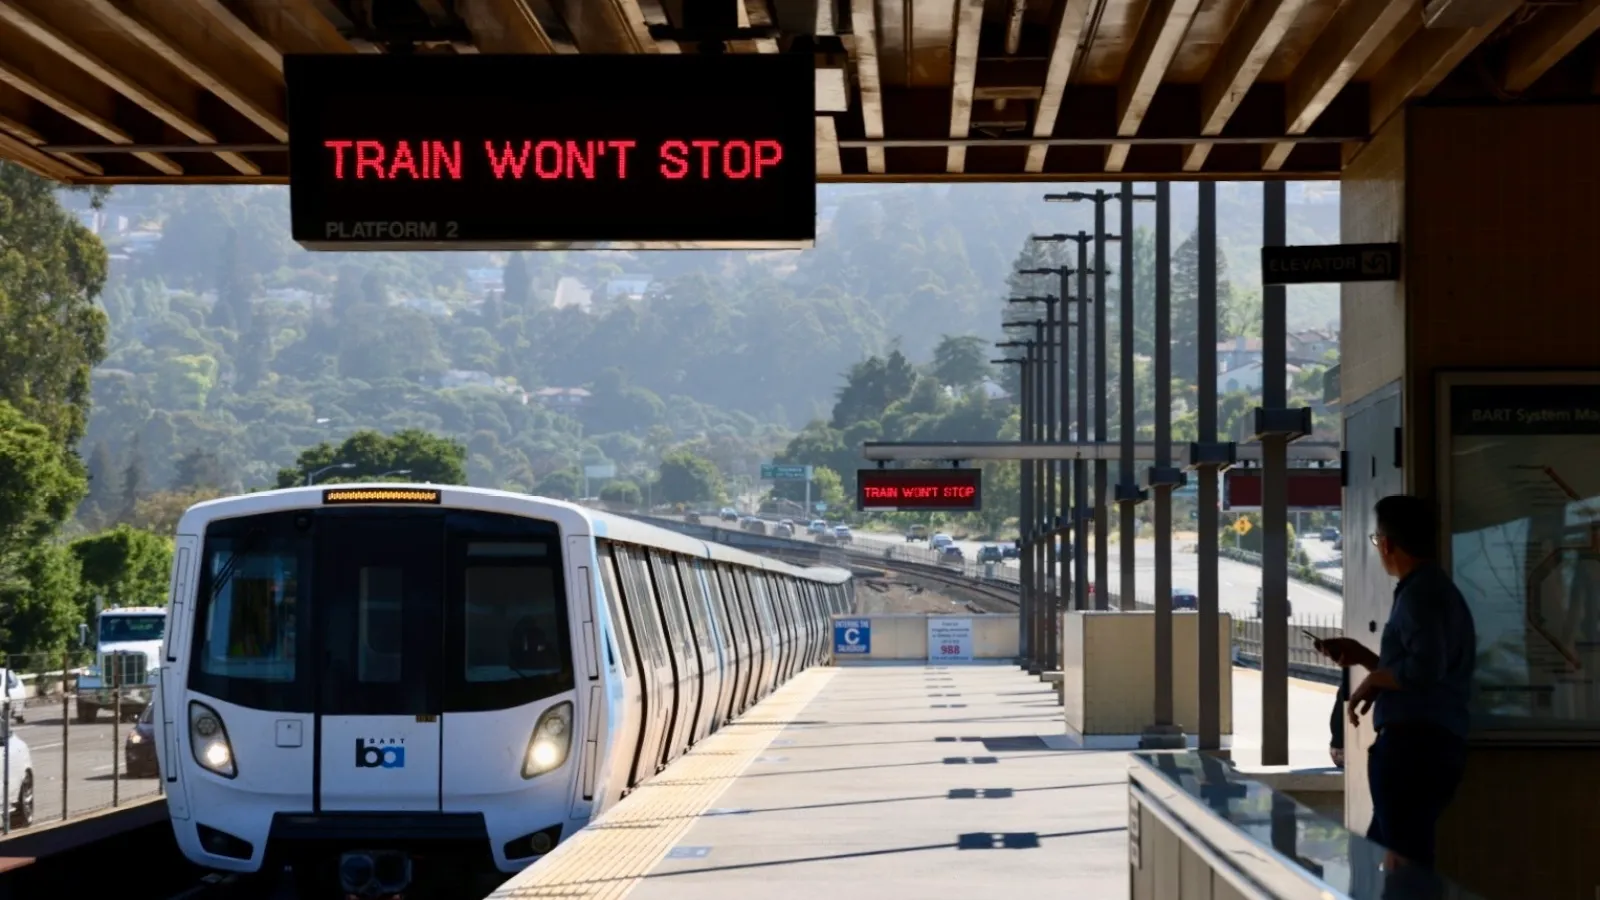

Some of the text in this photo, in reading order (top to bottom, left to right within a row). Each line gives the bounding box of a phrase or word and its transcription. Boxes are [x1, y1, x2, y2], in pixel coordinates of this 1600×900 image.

[325, 140, 783, 179] TRAIN WON'T STOP
[325, 220, 459, 239] PLATFORM 2
[1269, 255, 1356, 272] ELEVATOR
[1471, 408, 1600, 424] BART System Ma
[864, 487, 975, 498] TRAIN WON'T STOP
[844, 628, 860, 645] C
[940, 645, 961, 655] 988
